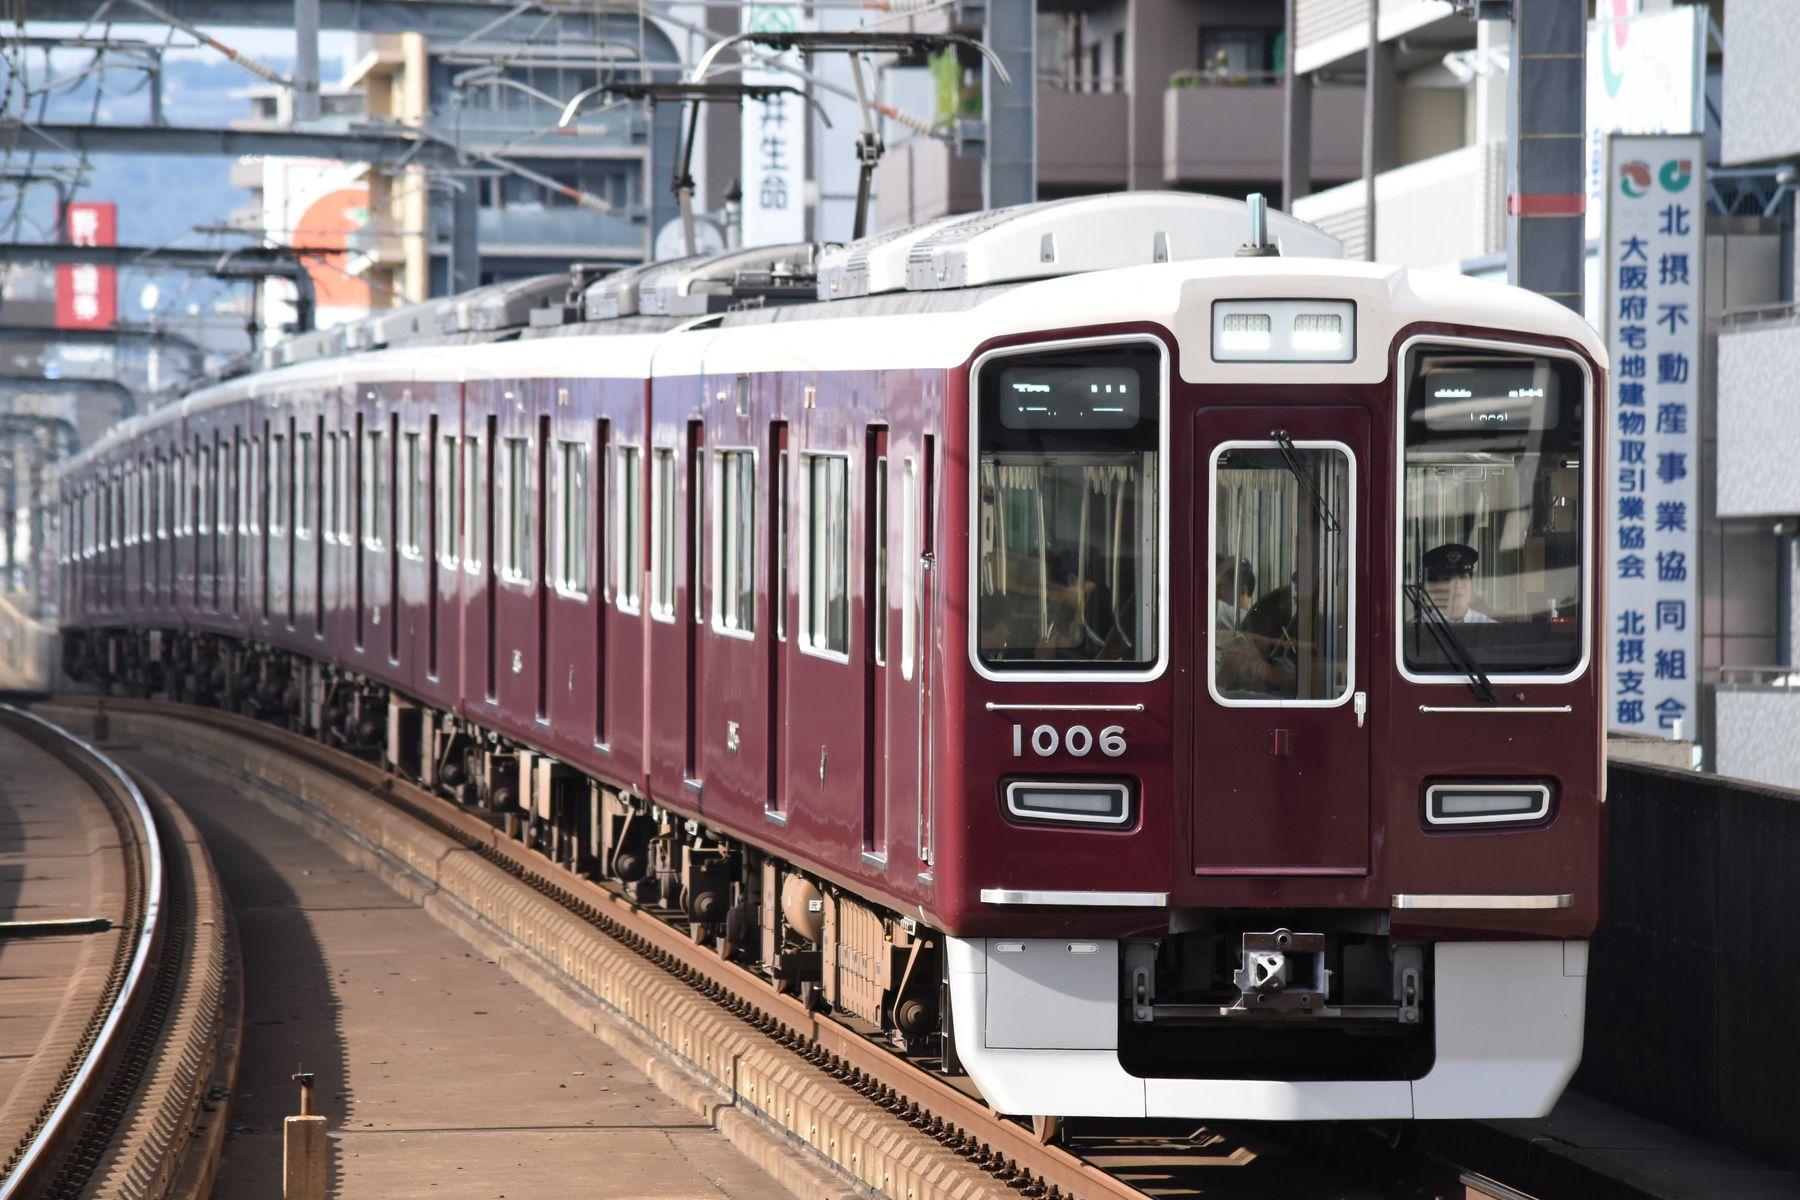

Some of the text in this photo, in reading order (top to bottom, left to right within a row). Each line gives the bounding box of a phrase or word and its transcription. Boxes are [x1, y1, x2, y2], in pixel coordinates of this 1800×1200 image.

[1617, 235, 1648, 580] 大阪府宅地建物取引業協会
[1654, 203, 1690, 730] 北摂不動産事業協同組合
[1013, 724, 1127, 757] 1006
[1616, 610, 1645, 725] 北摂支部
